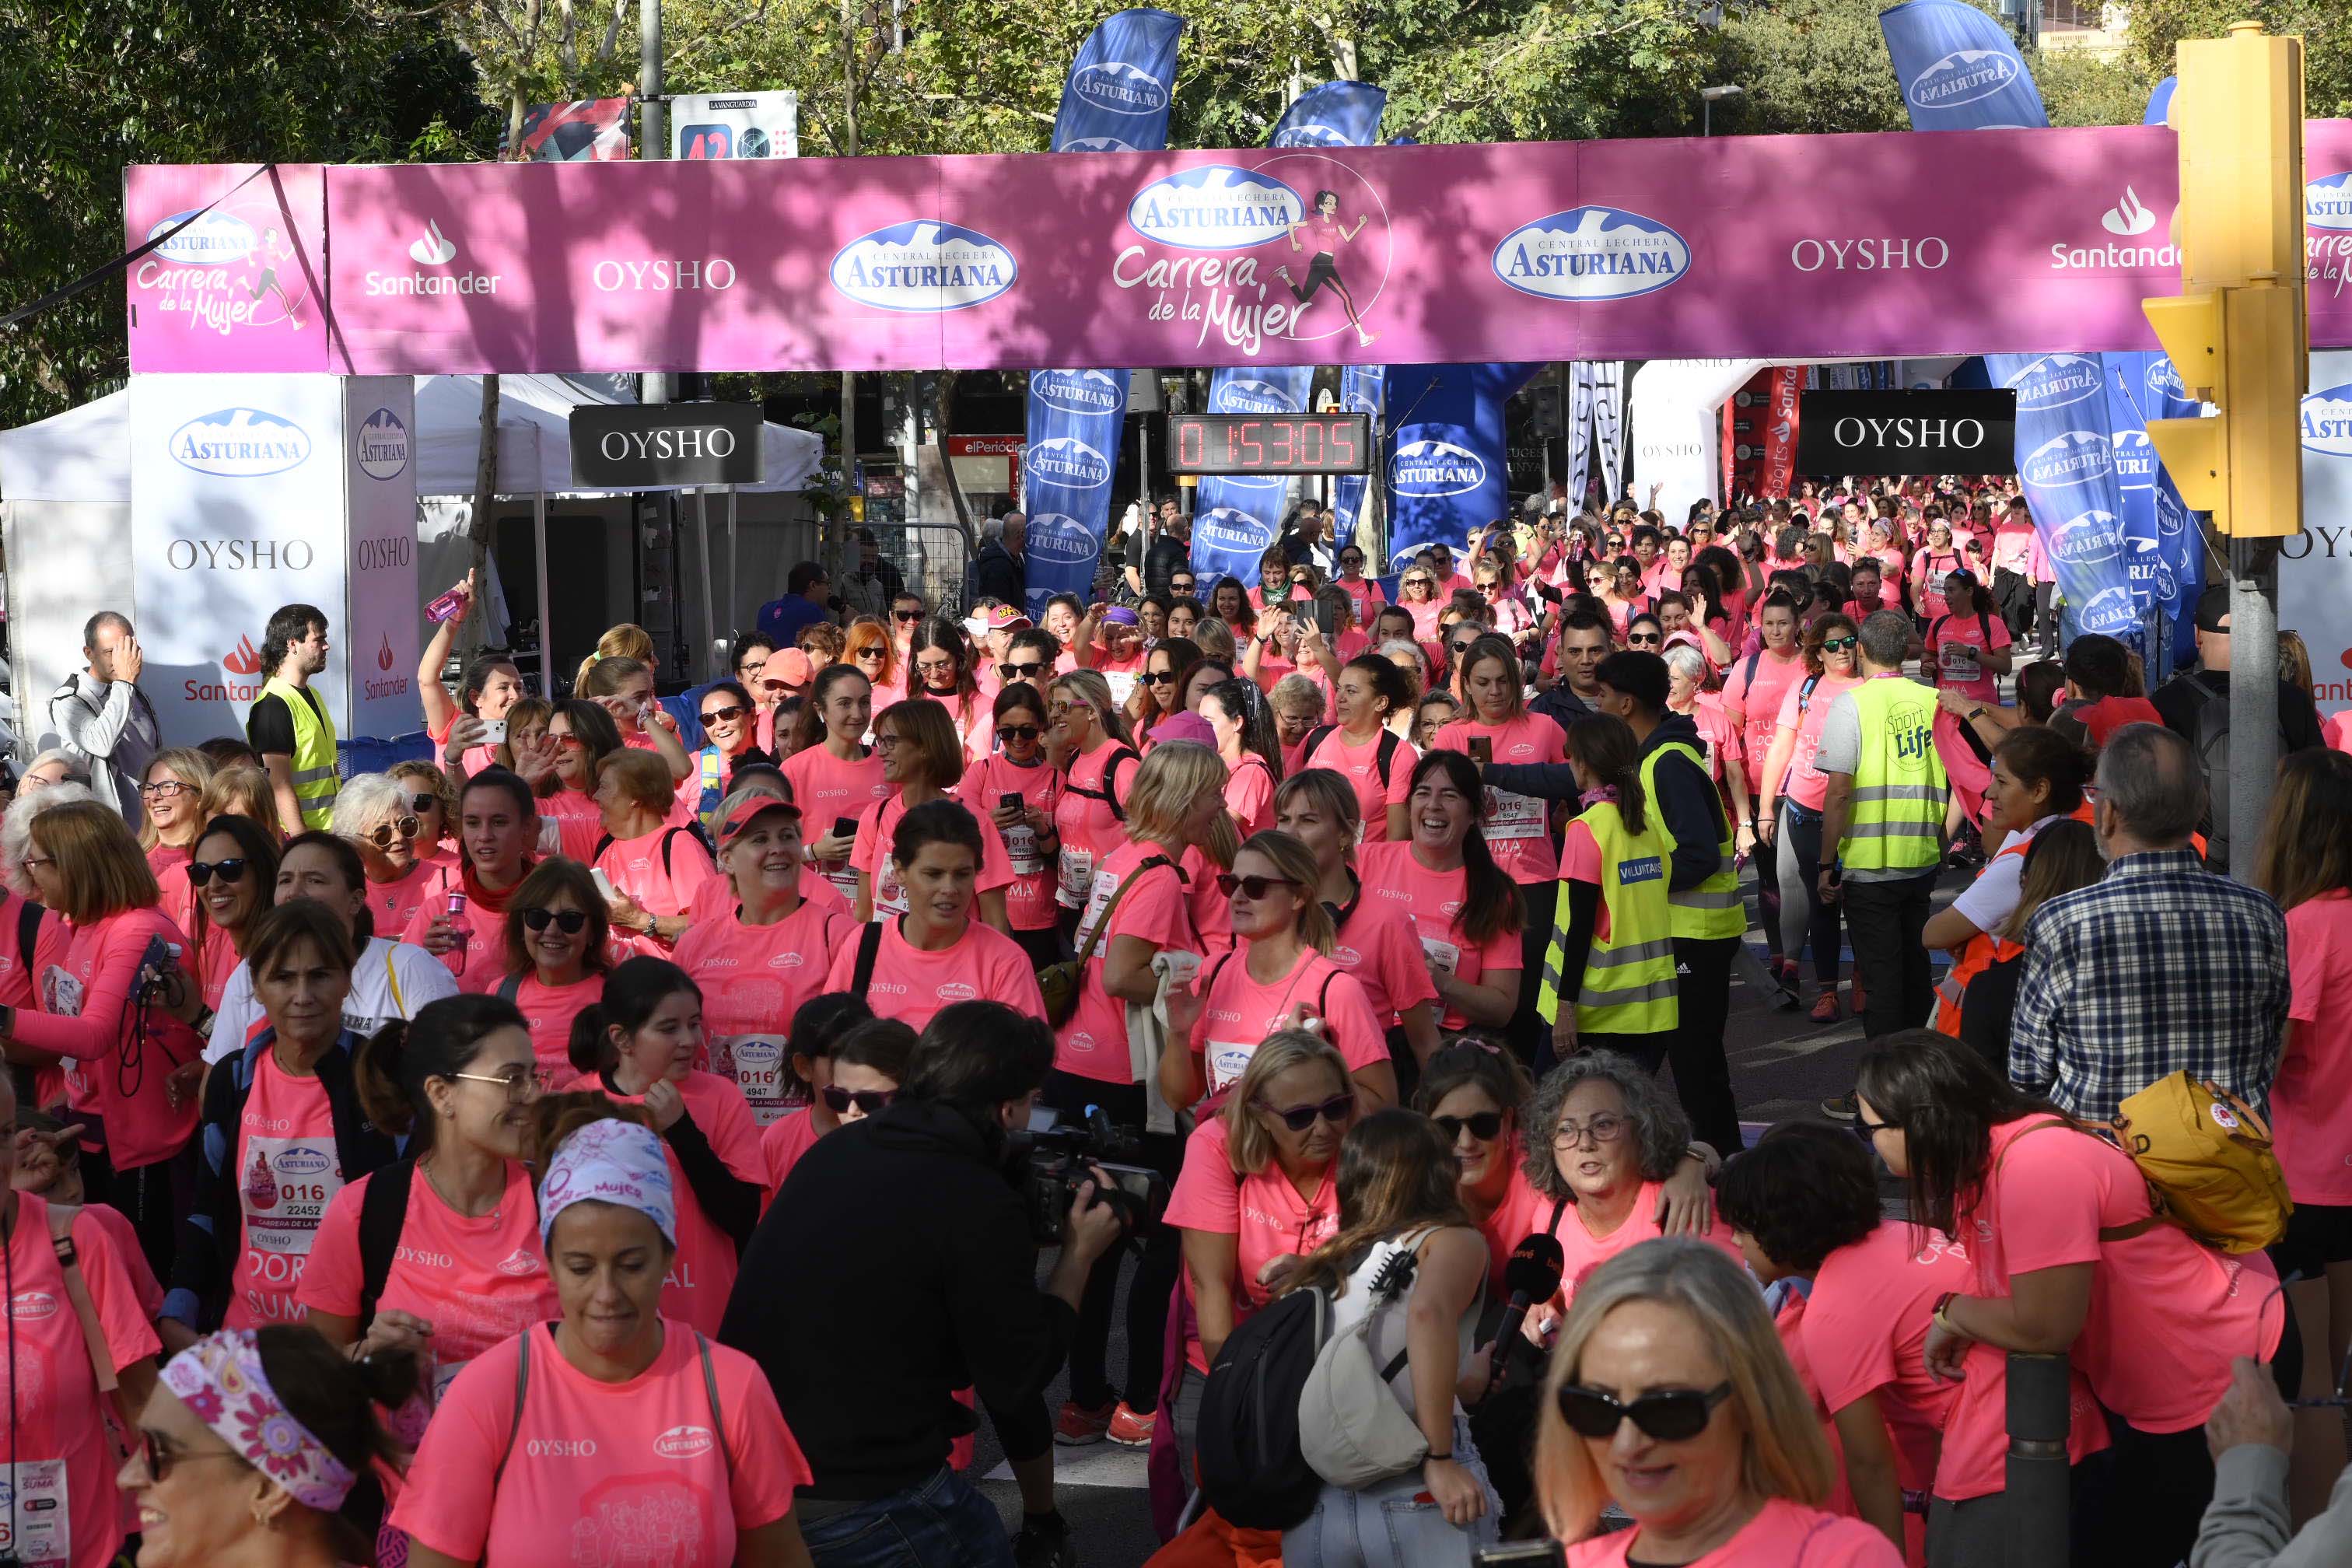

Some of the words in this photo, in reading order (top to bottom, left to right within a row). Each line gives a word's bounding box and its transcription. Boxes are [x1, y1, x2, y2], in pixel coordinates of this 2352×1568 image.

[1079, 73, 1159, 107] ASTURIANA
[717, 100, 757, 109] VANGUARDIA
[1141, 198, 1291, 228] ASTURIANA
[1538, 239, 1599, 250] CENTRAL
[1605, 236, 1669, 248] LECHERA
[1791, 236, 1950, 272] OYSHO
[873, 251, 931, 261] CENTRAL
[937, 251, 996, 261] LECHERA
[1113, 245, 1258, 289] Carrera
[1507, 242, 1675, 277] ASTURIANA
[2051, 242, 2182, 269] Santand
[137, 261, 228, 289] Carrera
[593, 259, 736, 291] OYSHO
[845, 255, 1003, 288] ASTURIANA
[2323, 258, 2337, 279] la
[366, 271, 501, 296] Santander
[159, 292, 177, 311] de
[180, 292, 193, 311] la
[191, 289, 263, 336] Mujer
[1148, 290, 1175, 321] de
[1181, 289, 1201, 320] la
[1197, 284, 1312, 356] Mujer
[1039, 376, 1115, 408] ASTURIANA
[600, 427, 736, 461] OYSHO
[1834, 417, 1985, 450] OYSHO
[180, 433, 301, 460] ASTURIANA
[360, 434, 405, 463] ASTURIANA
[1032, 450, 1103, 481] ASTURIANA
[1391, 464, 1479, 485] ASTURIANA
[166, 539, 313, 571] OYSHO
[359, 535, 410, 572] OYSHO
[2280, 526, 2352, 560] OY
[365, 674, 408, 701] Santander
[2314, 678, 2352, 702] ant
[1754, 720, 1772, 731] TU
[1887, 705, 1924, 735] Sport
[1804, 734, 1820, 747] TU
[1895, 724, 1933, 758] Life
[817, 789, 848, 799] OYSHO
[1498, 801, 1521, 810] 016
[1012, 835, 1034, 845] 016
[701, 958, 739, 967] OYSHO
[738, 1048, 776, 1059] ASTURIANA
[740, 1069, 774, 1084] 016
[746, 1087, 767, 1097] 4947
[245, 1112, 291, 1132] OYSHO
[278, 1156, 326, 1169] ASTURIANA
[282, 1184, 325, 1201] 016
[286, 1205, 320, 1216] 22452
[291, 1219, 301, 1227] DE
[257, 1233, 291, 1245] OYSHO
[394, 1245, 453, 1269] OYSHO
[248, 1289, 310, 1321] SUM
[527, 1440, 596, 1458] OYSHO
[660, 1438, 712, 1453] ASTURIANA
[22, 1479, 54, 1489] SUMA
